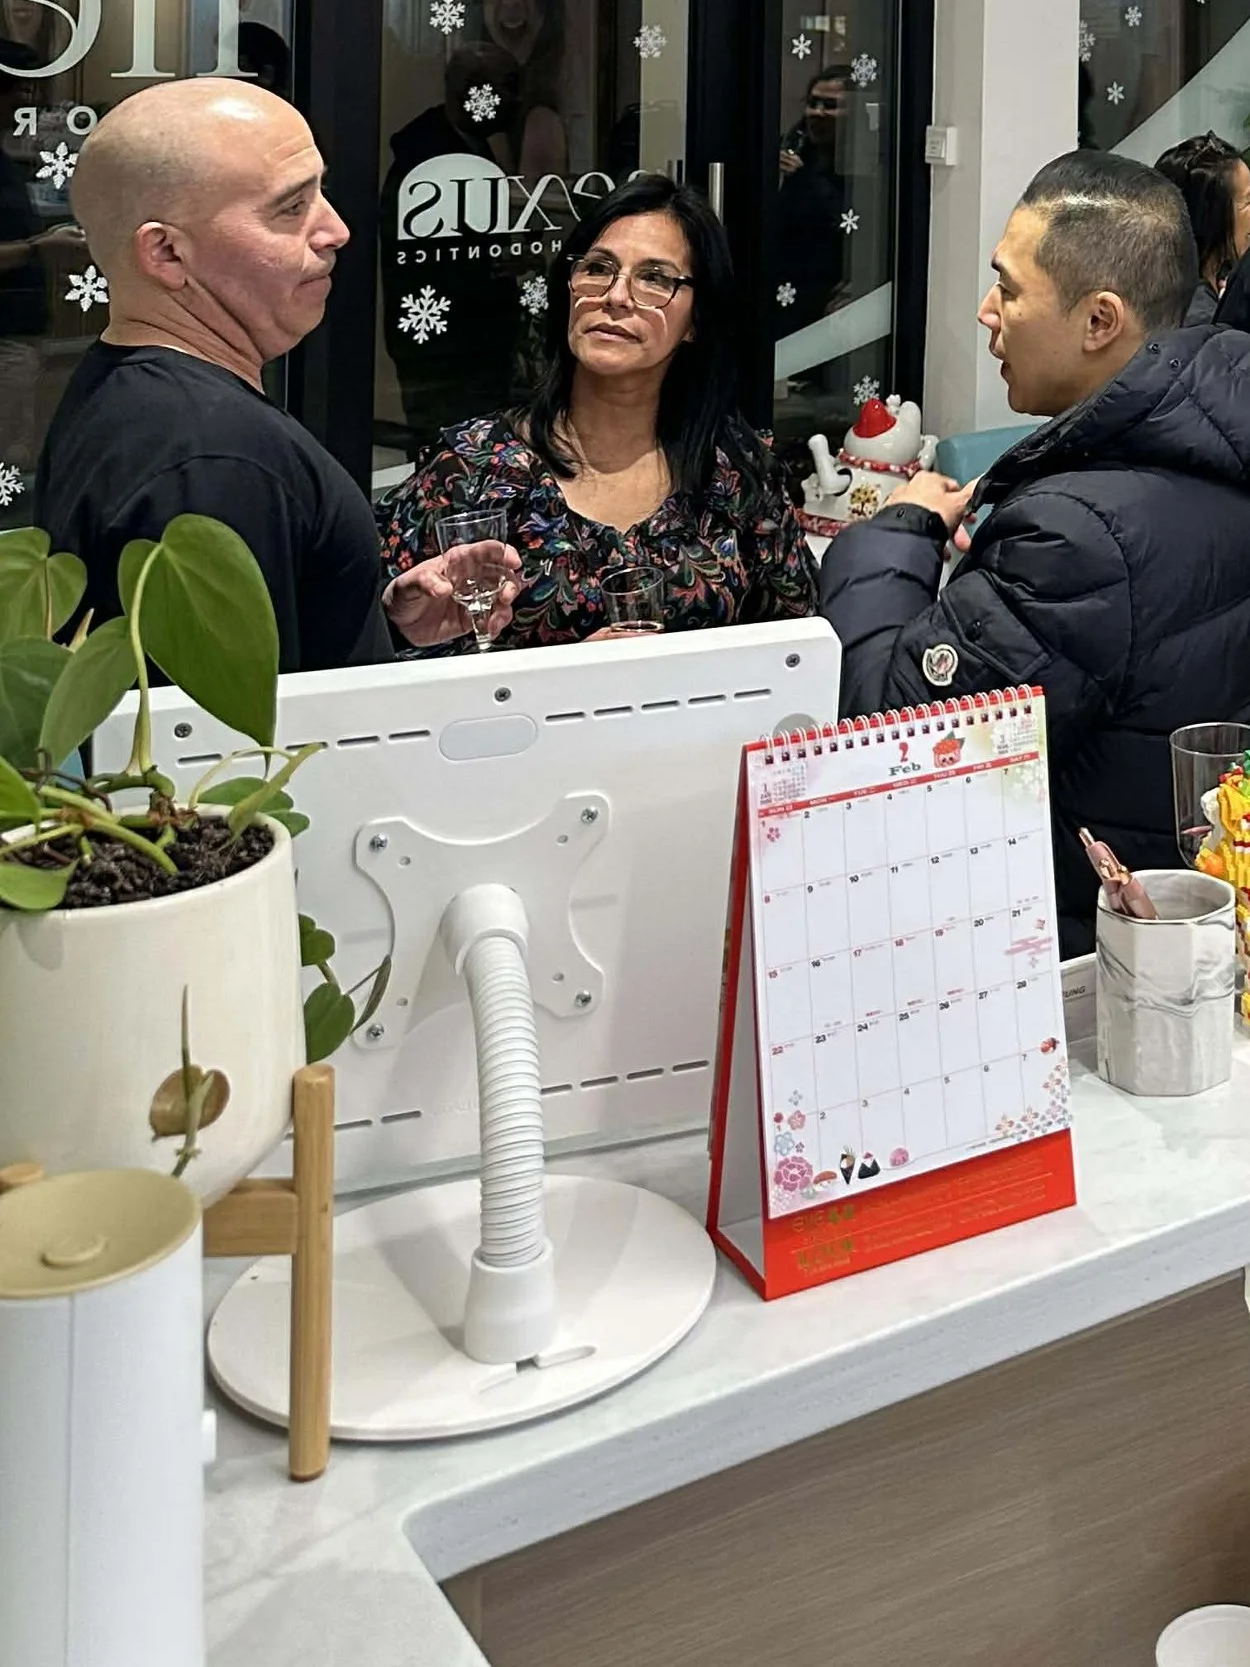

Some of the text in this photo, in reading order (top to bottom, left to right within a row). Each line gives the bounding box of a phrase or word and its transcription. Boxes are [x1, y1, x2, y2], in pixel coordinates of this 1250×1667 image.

[900, 742, 909, 763] 2
[889, 762, 921, 777] Feb
[846, 802, 851, 810] 3
[850, 875, 858, 883] 10
[931, 856, 939, 864] 12
[768, 970, 777, 978] 15
[854, 949, 861, 957] 17
[974, 919, 984, 927] 20
[772, 981, 1026, 1055] 22 23 24 25 26 27 28
